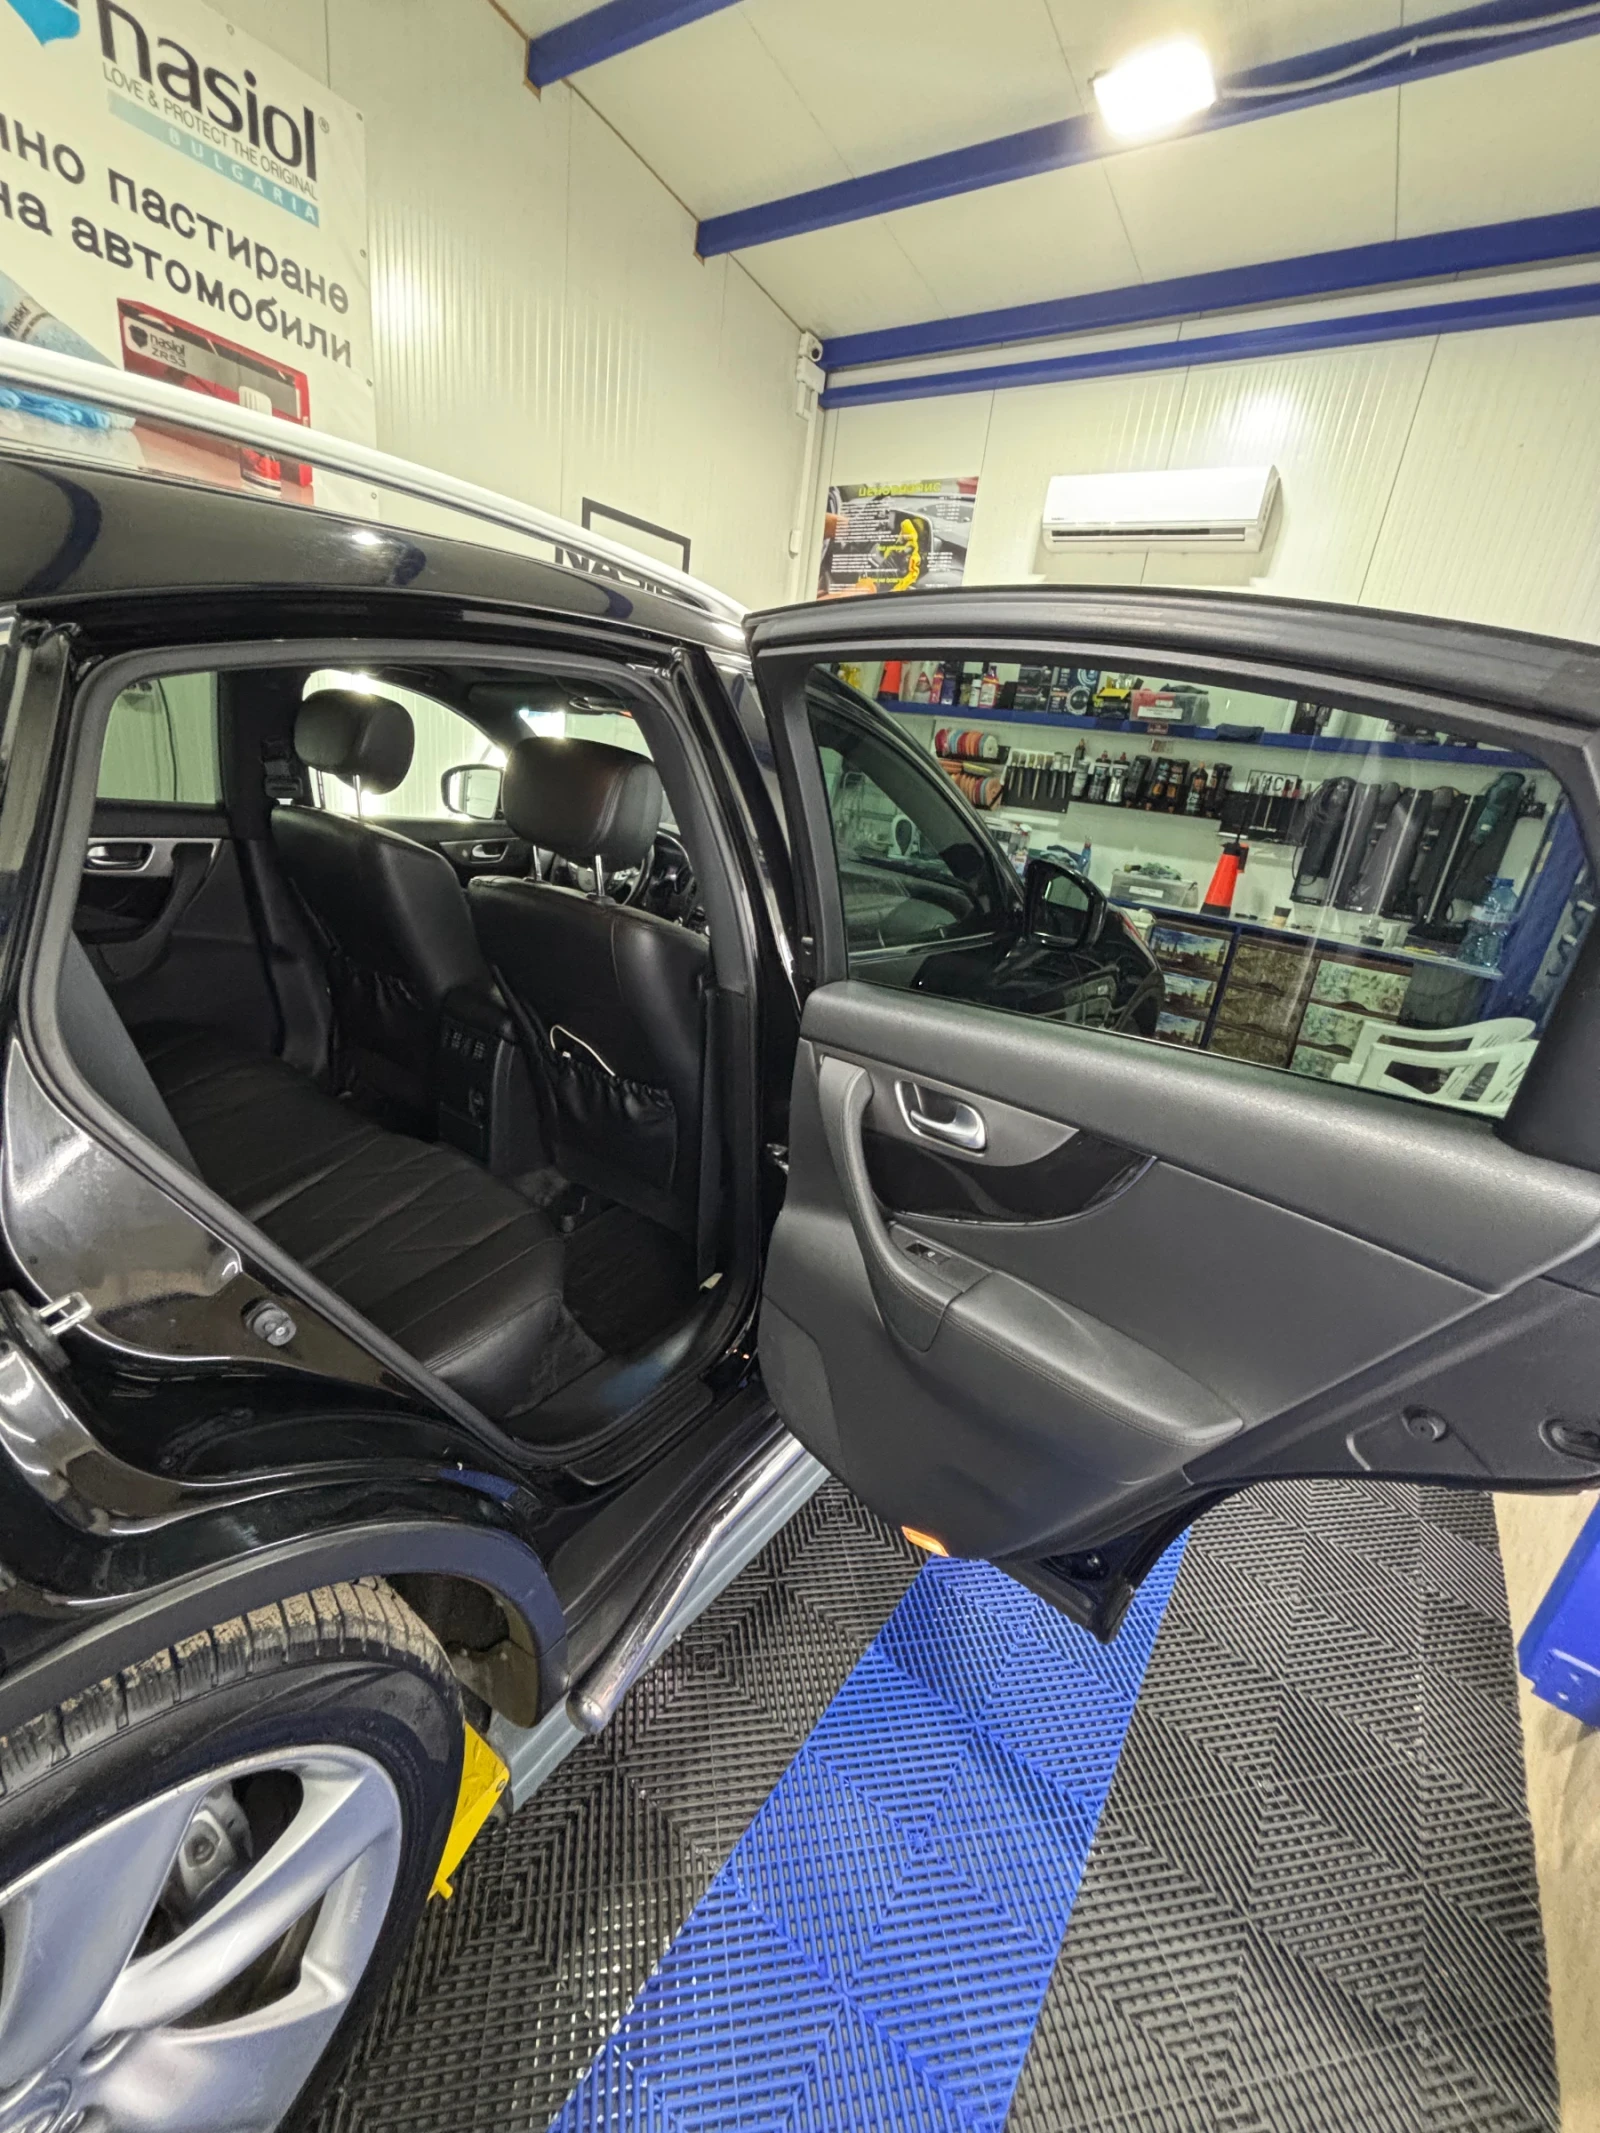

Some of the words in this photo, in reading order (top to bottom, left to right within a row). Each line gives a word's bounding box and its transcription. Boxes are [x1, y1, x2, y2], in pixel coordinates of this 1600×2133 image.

[96, 0, 318, 183] nasiol
[102, 61, 145, 102] LOVE
[147, 88, 160, 111] &
[163, 97, 229, 147] PROTECT
[231, 136, 259, 167] THE
[260, 154, 319, 202] ORIGINAL
[0, 112, 86, 185] но
[107, 167, 349, 315] пастиране
[169, 126, 316, 223] BULGARIA
[71, 215, 352, 369] автомобили
